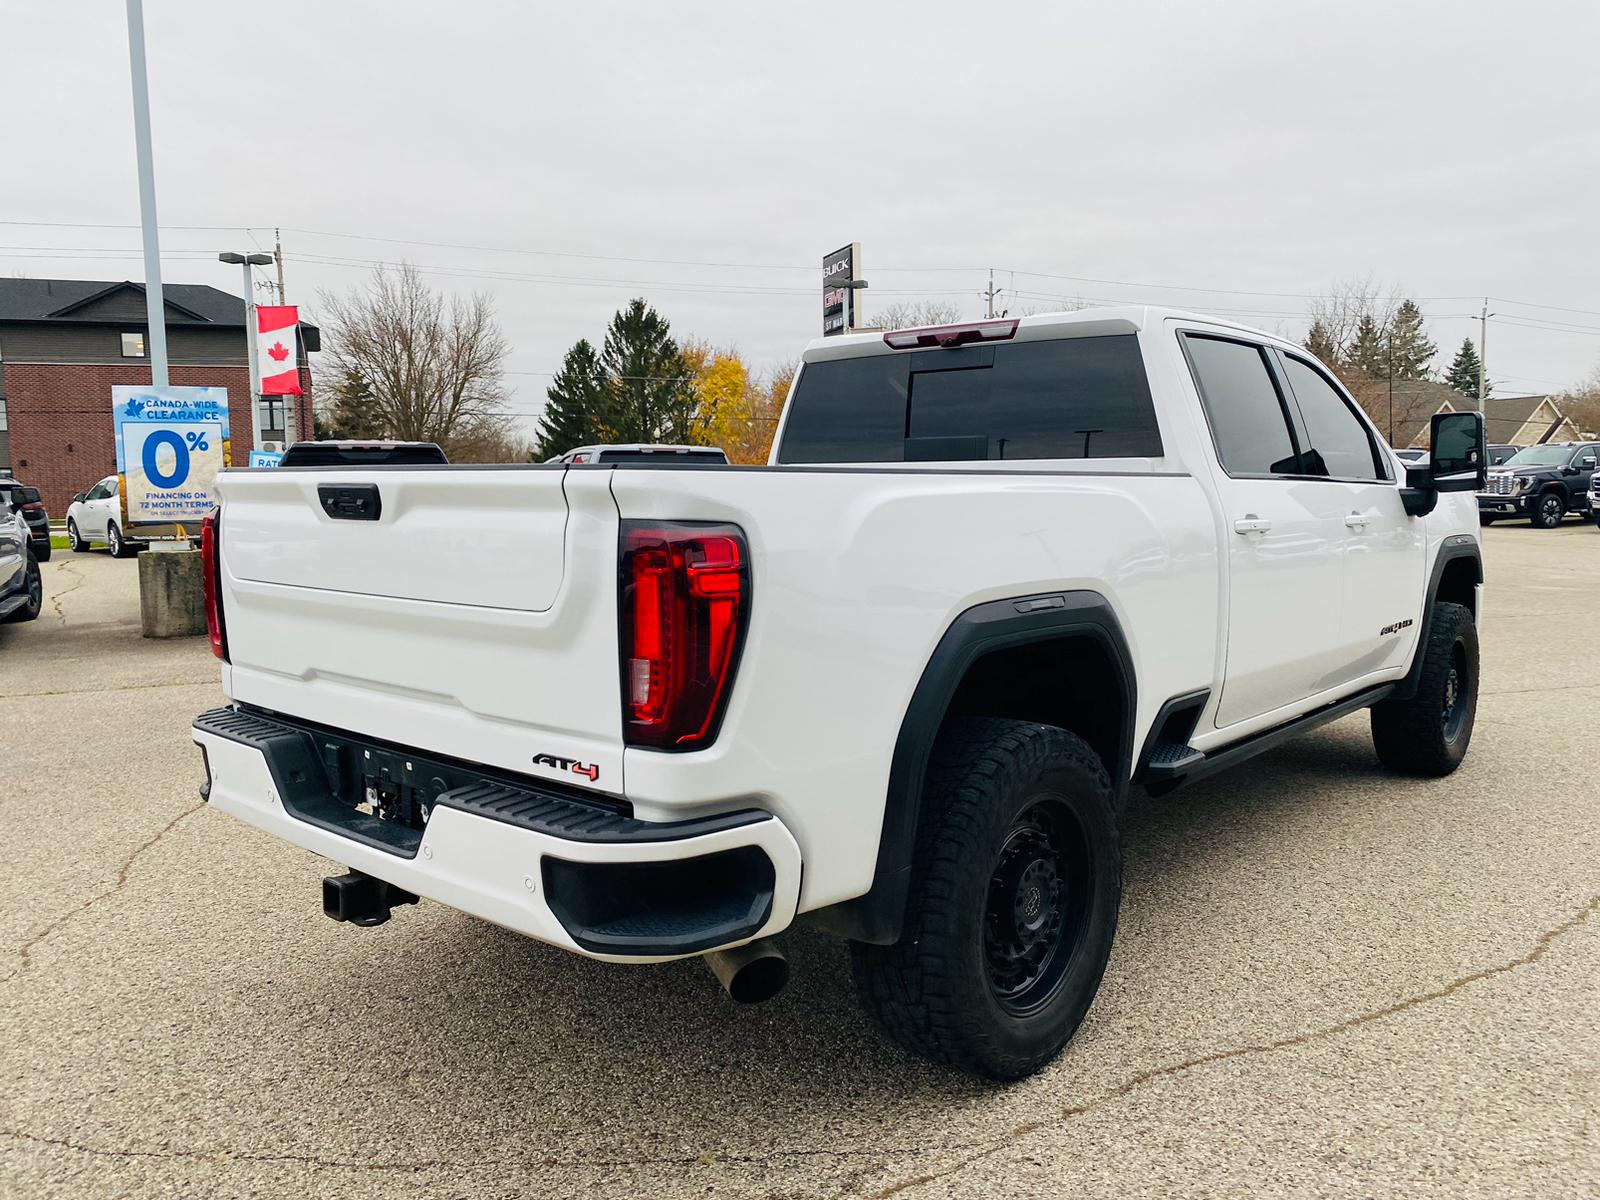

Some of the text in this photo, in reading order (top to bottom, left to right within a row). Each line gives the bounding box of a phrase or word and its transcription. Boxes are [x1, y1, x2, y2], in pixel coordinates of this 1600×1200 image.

[823, 258, 849, 278] BUICK
[146, 400, 218, 409] CANADA-WIDE
[147, 410, 219, 420] CLEARANCE
[142, 430, 209, 489] 0%
[185, 500, 214, 508] TERMS
[532, 752, 599, 782] AT4
